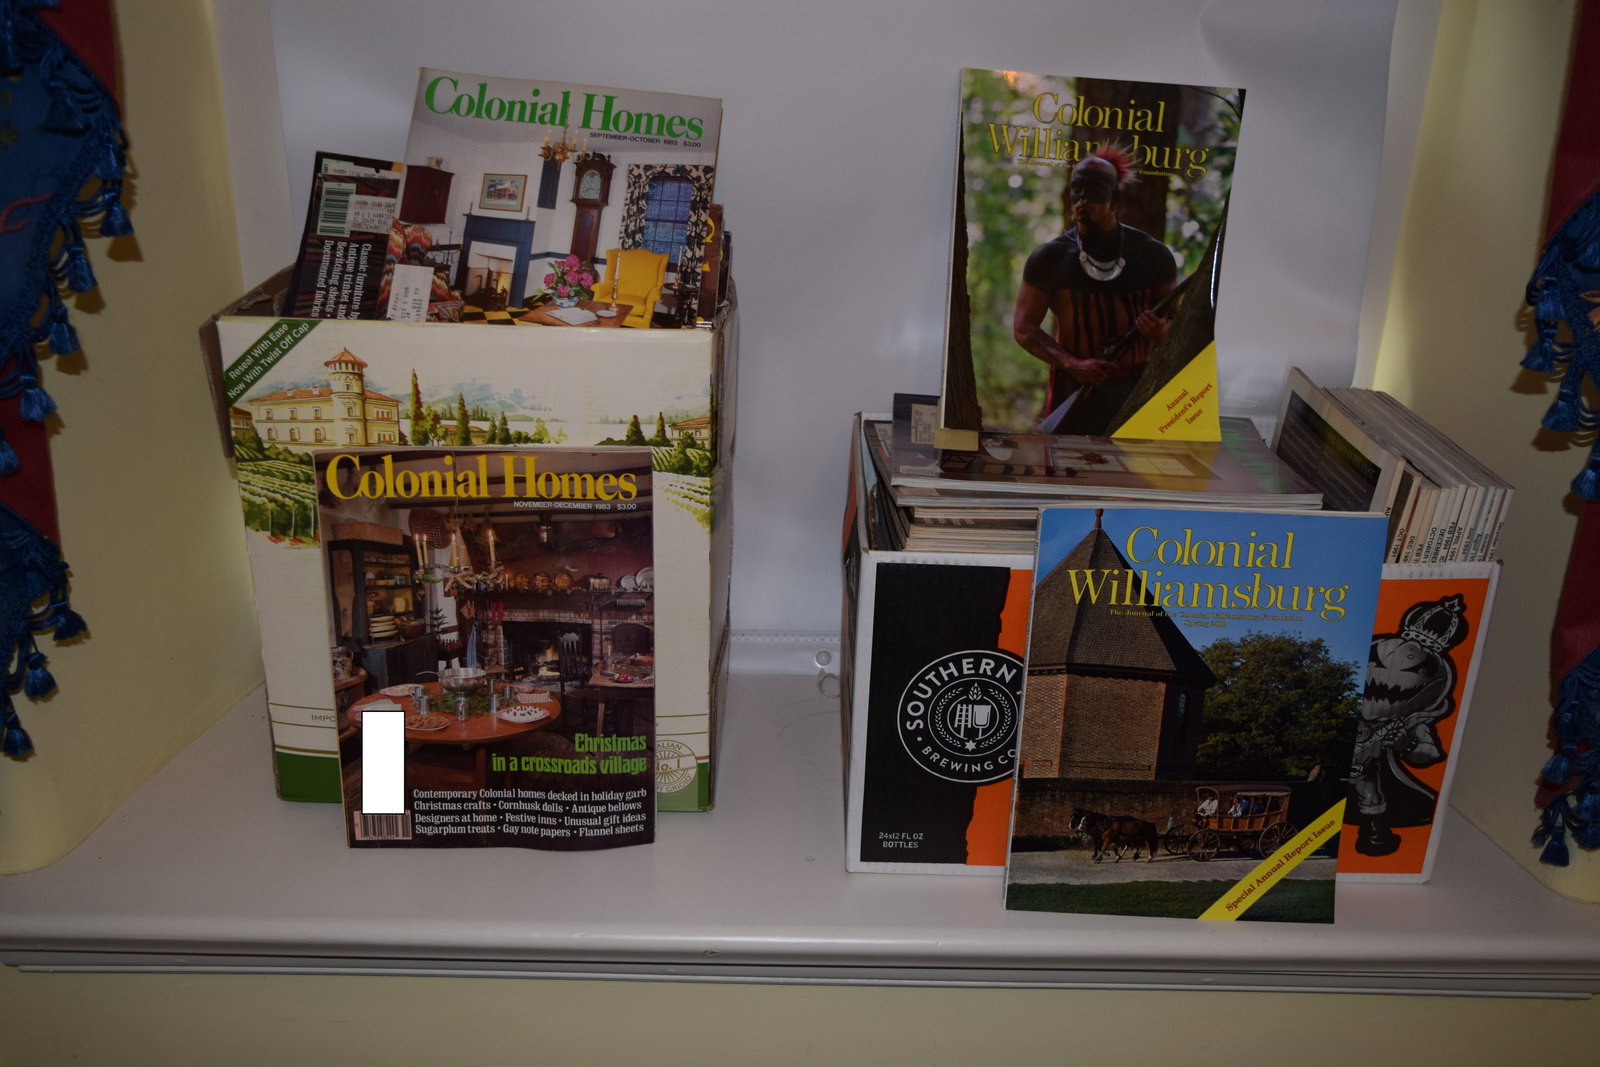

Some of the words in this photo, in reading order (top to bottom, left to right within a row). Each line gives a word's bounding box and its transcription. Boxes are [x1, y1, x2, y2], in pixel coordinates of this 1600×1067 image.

[425, 76, 571, 127] Colonial
[578, 93, 704, 141] Homes
[1033, 92, 1166, 133] Colonial
[589, 132, 661, 144] SEPTEMBER-OCTOBER
[987, 122, 1210, 178] Williaburg
[316, 239, 334, 288] Documented
[328, 241, 347, 286] Bewitching
[345, 242, 359, 272] Antique
[359, 243, 372, 272] Classic
[325, 286, 339, 313] sheets
[341, 272, 356, 303] trinket
[351, 271, 368, 308] furniture
[311, 289, 325, 318] fabrics
[337, 302, 350, 319] and
[227, 381, 246, 399] Now
[243, 364, 264, 384] With
[260, 347, 282, 367] Twist
[280, 335, 294, 350] Off
[292, 322, 310, 338] Cap
[228, 355, 255, 380] Reseal
[251, 338, 272, 358] With
[269, 323, 289, 342] Ease
[1159, 403, 1193, 434] President's
[1190, 384, 1213, 404] Report
[1167, 389, 1189, 411] Annual
[1186, 409, 1203, 424] Issue
[326, 453, 491, 500] Colonial
[500, 455, 638, 501] Homes
[513, 501, 593, 510] NOVEMBER-DECEMBER
[616, 503, 637, 511] $3.00
[1126, 526, 1294, 569] Colonial
[1407, 536, 1415, 549] DEC
[1423, 527, 1437, 559] OCTOBER
[1453, 527, 1462, 545] APRIL
[1067, 569, 1350, 621] Williamsburg
[906, 657, 1017, 731] SOUTHERN
[574, 732, 647, 752] Christmas
[491, 753, 506, 772] in
[509, 756, 518, 771] a
[521, 755, 597, 775] crossroads
[600, 755, 647, 775] village
[921, 745, 994, 773] BREWING
[413, 789, 478, 800] Contemporary
[479, 788, 515, 798] Colonial
[517, 788, 546, 799] homes
[547, 790, 578, 801] decked
[580, 791, 590, 801] in
[591, 791, 624, 801] holiday
[625, 788, 647, 800] garb
[414, 800, 461, 811] Christmas
[463, 800, 491, 810] crafts
[498, 800, 541, 811] Cornhusk
[542, 802, 563, 813] dolls
[571, 804, 606, 815] Antique
[608, 801, 642, 812] bellows
[415, 813, 460, 824] Designers
[461, 813, 471, 822] at
[472, 813, 498, 823] home
[505, 812, 536, 823] Festive
[537, 815, 557, 825] inns
[564, 816, 602, 826] Unusual
[603, 815, 621, 827] gift
[622, 813, 647, 823] ideas
[415, 824, 466, 836] Sugarplum
[467, 825, 496, 834] treats
[503, 824, 520, 835] Gay
[520, 825, 540, 835] note
[540, 827, 571, 838] papers
[579, 825, 613, 837] Flannel
[614, 823, 644, 835] sheets
[878, 832, 900, 840] 24x12
[901, 832, 912, 840] FL
[913, 832, 924, 840] OZ
[1225, 884, 1256, 912] Special
[1256, 859, 1286, 887] Annual
[1283, 836, 1314, 862] Report
[1311, 819, 1336, 839] Issue
